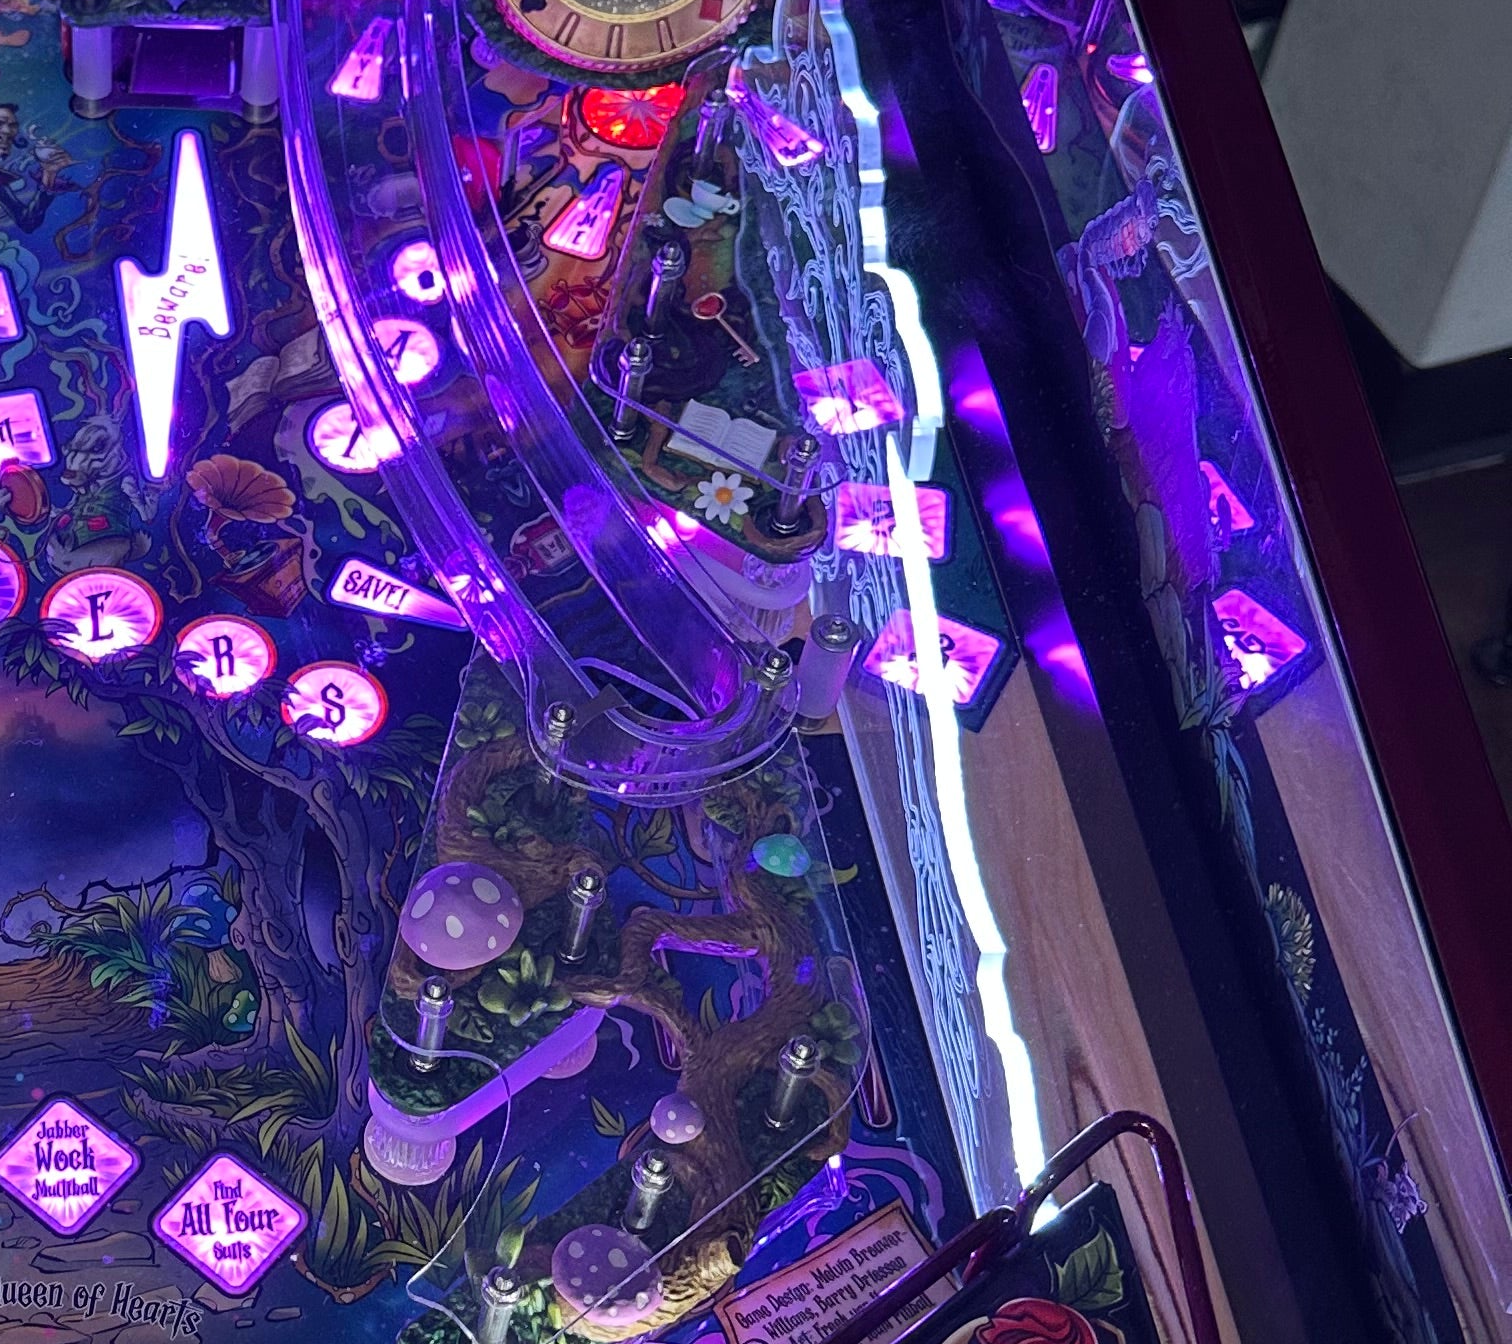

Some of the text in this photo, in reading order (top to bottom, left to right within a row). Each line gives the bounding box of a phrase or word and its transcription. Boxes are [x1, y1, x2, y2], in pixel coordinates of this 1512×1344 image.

[343, 570, 410, 610] SAVE!
[87, 589, 113, 642] E
[211, 634, 235, 680] R
[321, 682, 345, 728] S
[36, 1120, 90, 1140] Jabber
[33, 1139, 96, 1172] Wock
[32, 1177, 100, 1200] Multiball
[213, 1179, 242, 1201] Find
[178, 1201, 279, 1236] All Four
[212, 1241, 252, 1262] Suits
[73, 1283, 105, 1319] of
[112, 1281, 202, 1340] Hearts
[734, 1305, 772, 1331] Game
[765, 1282, 814, 1314] Design:
[809, 1258, 854, 1291] Melvin
[762, 1304, 820, 1341] Williams,
[813, 1284, 857, 1314] Barry
